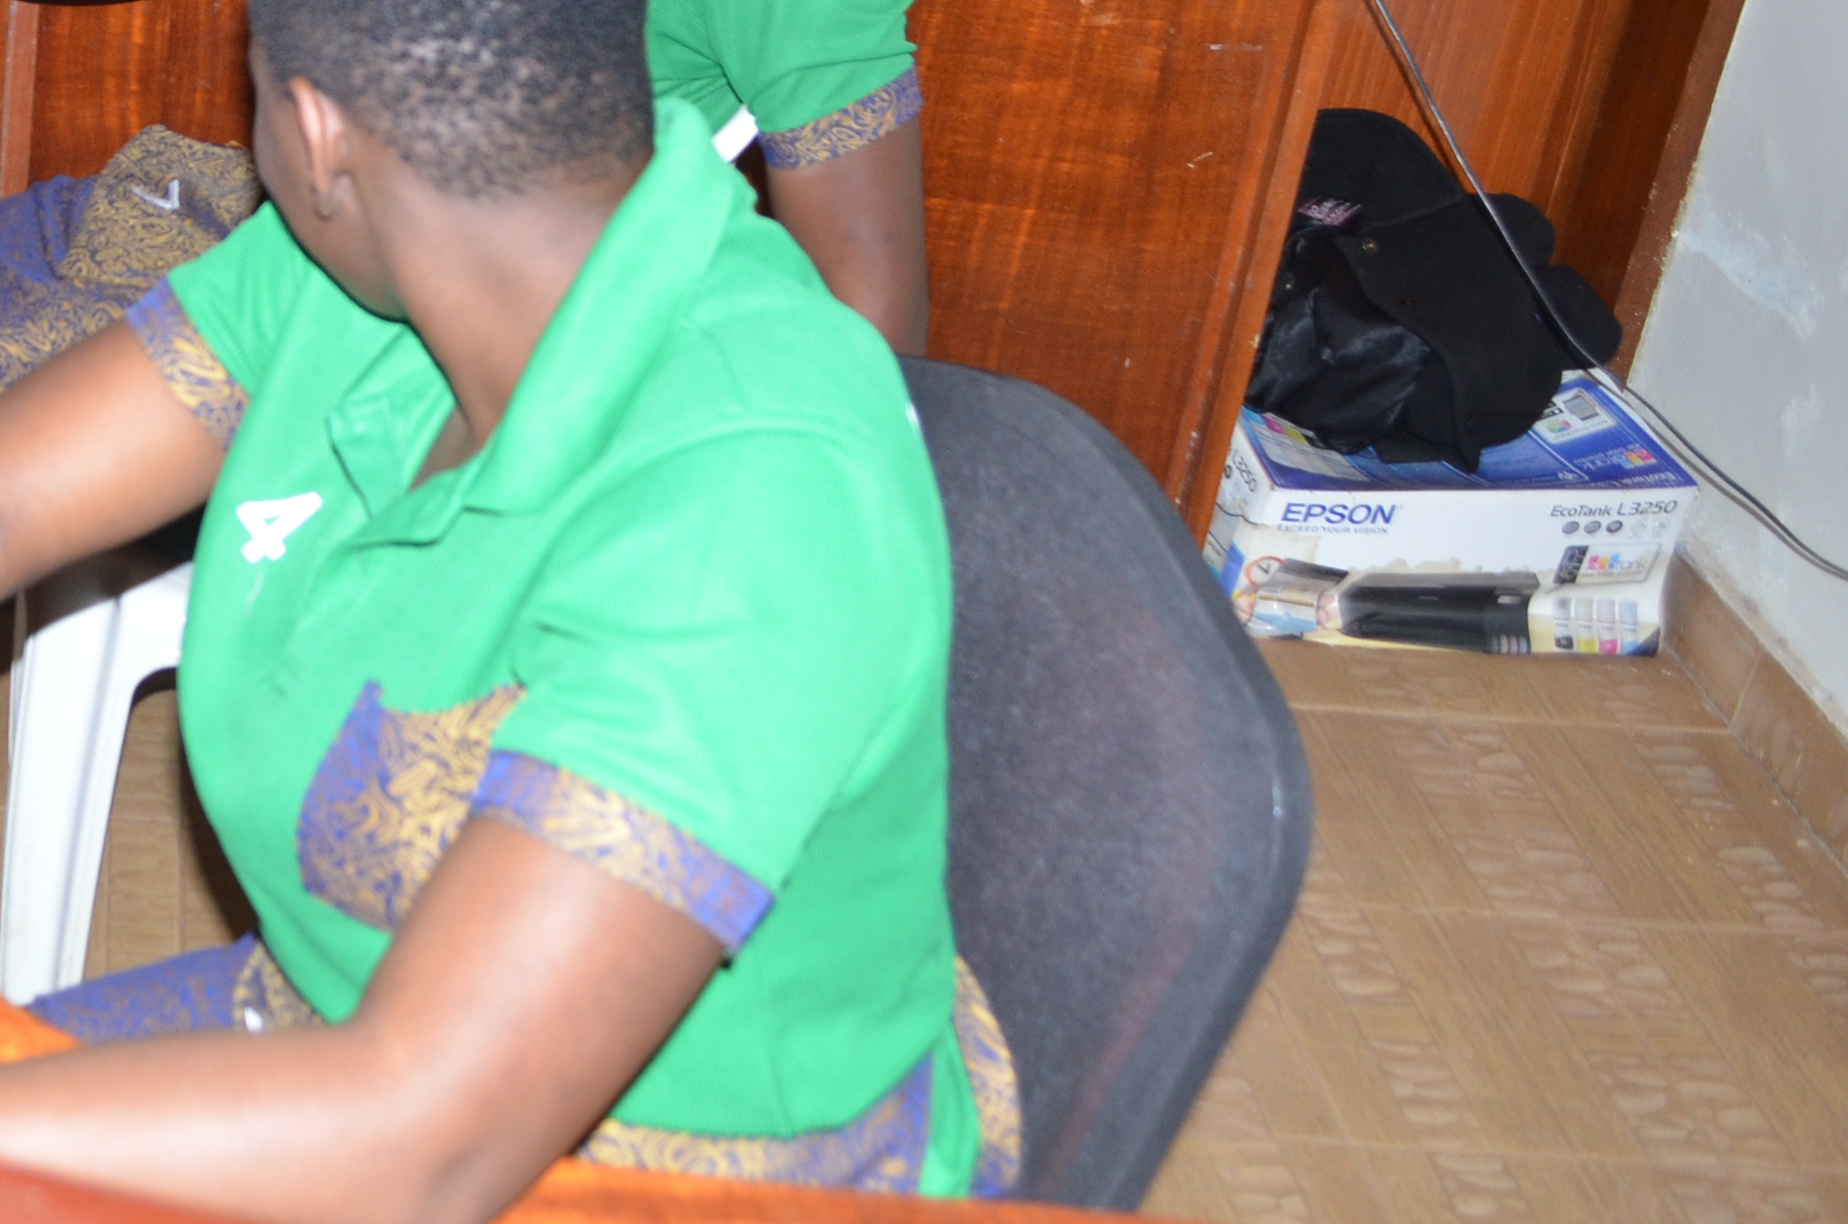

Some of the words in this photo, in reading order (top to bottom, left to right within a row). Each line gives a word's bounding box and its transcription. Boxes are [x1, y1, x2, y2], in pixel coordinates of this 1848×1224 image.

[1280, 502, 1397, 526] EPSON
[1550, 505, 1612, 518] EcoTank
[1616, 499, 1679, 517] L3250
[1276, 523, 1319, 533] EXCEED
[1322, 525, 1350, 533] YOUR
[1353, 526, 1390, 534] VISION
